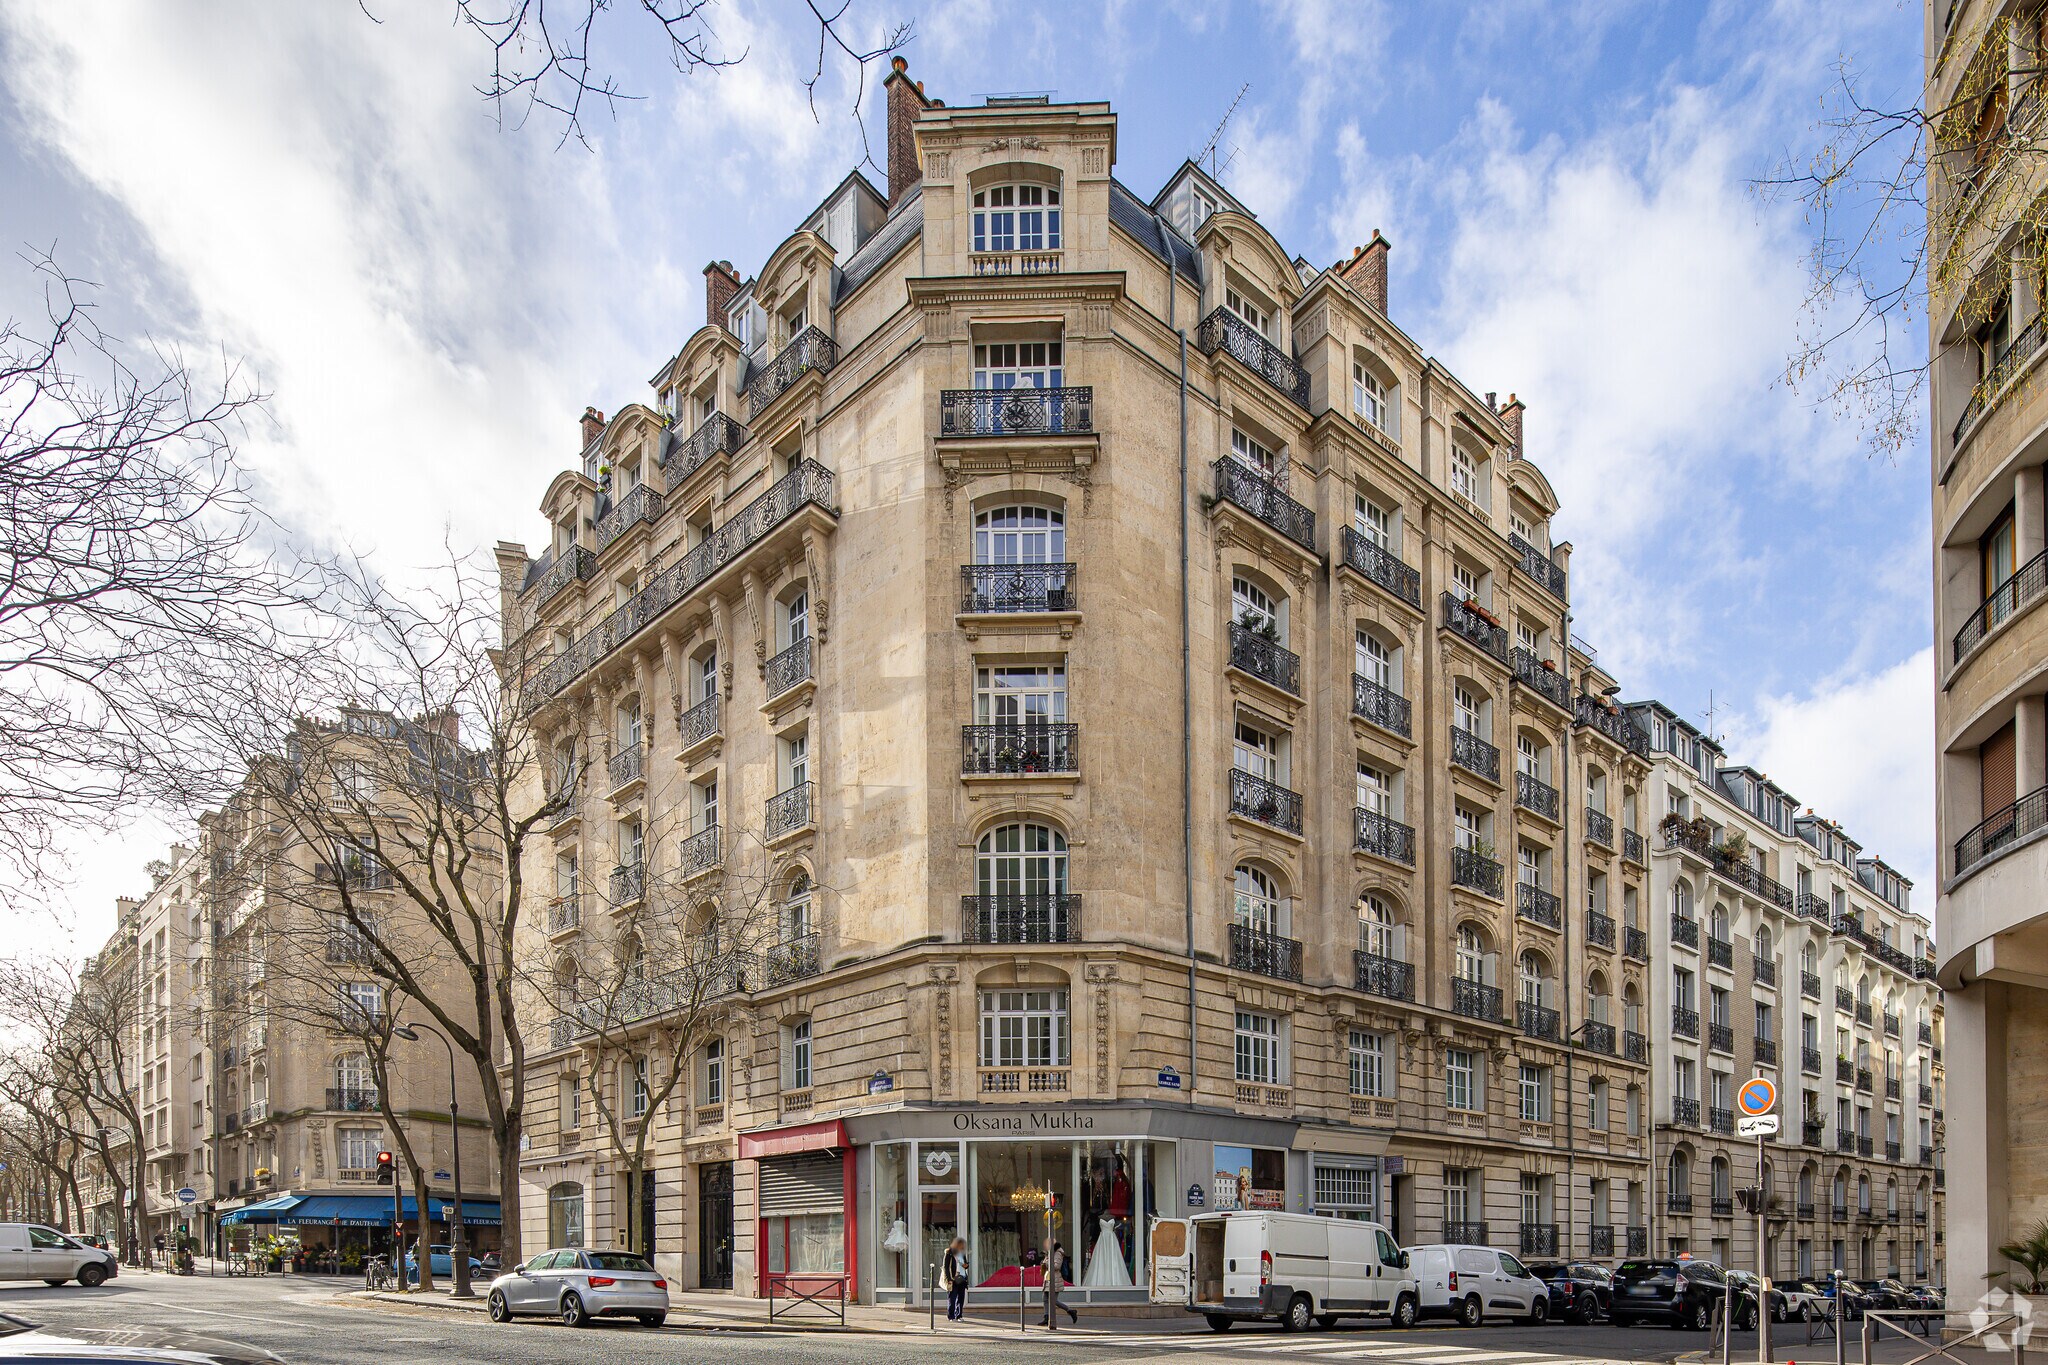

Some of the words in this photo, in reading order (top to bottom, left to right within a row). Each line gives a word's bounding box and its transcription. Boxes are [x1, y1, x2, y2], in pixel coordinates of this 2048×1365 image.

[953, 1112, 1022, 1130] Oksana
[1030, 1111, 1094, 1129] Mukha
[298, 1218, 348, 1226] FLEURANGEIE
[349, 1219, 380, 1227] D'AUTEUIL
